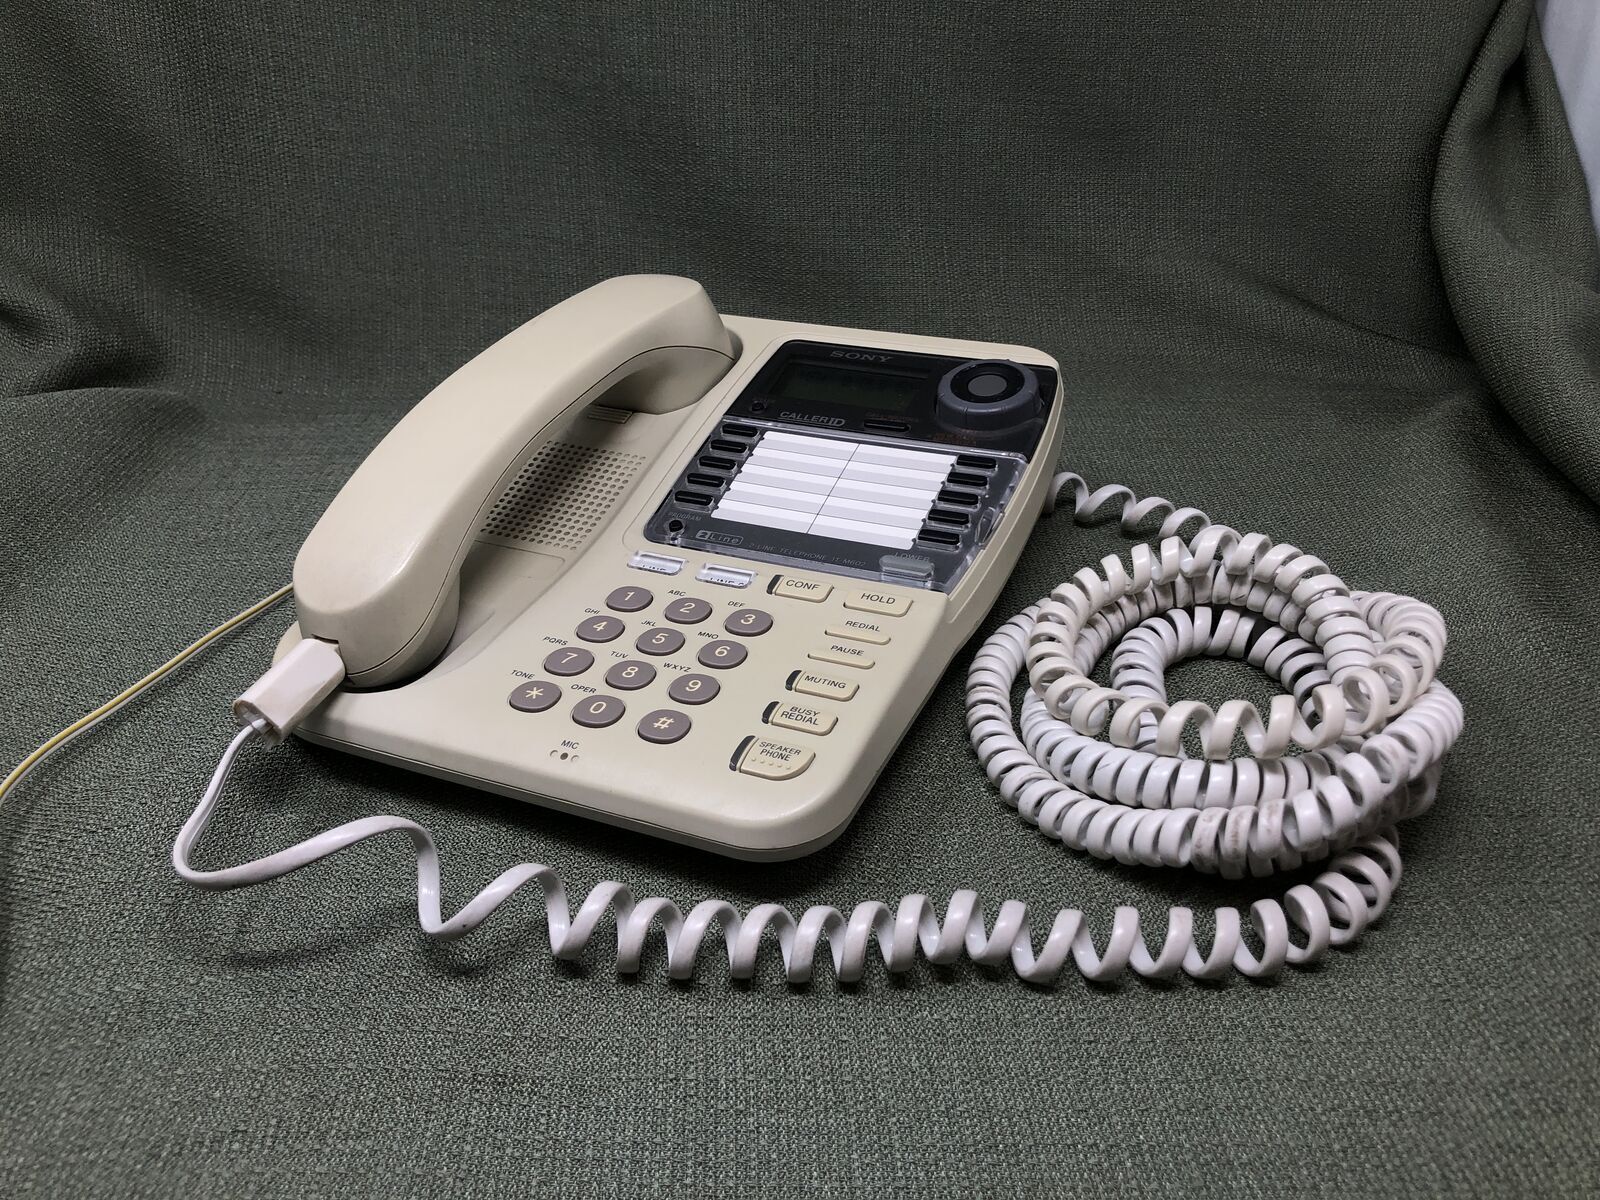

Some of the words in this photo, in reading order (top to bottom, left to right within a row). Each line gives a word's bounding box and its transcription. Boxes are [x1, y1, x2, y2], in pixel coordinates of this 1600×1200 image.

[830, 350, 892, 363] SONY
[786, 578, 820, 591] CONF
[624, 591, 634, 601] 1
[667, 589, 686, 597] ABC
[861, 592, 896, 605] HOLD
[679, 603, 696, 613] 2
[727, 600, 746, 608] DEF
[584, 607, 600, 615] GHI
[641, 619, 657, 627] JKL
[740, 614, 757, 625] 3
[593, 621, 608, 632] 4
[845, 620, 881, 632] REDIAL
[543, 636, 568, 646] PQRS
[652, 633, 669, 644] 5
[697, 631, 719, 640] MNO
[610, 650, 629, 659] TUV
[715, 646, 731, 657] 6
[830, 644, 865, 656] PAUSE
[562, 653, 579, 664] 7
[622, 666, 639, 678] 8
[663, 662, 692, 673] WXYZ
[511, 669, 535, 680] TONE
[685, 679, 701, 692] 9
[804, 675, 847, 689] MUTING
[570, 683, 597, 694] OPER
[590, 701, 606, 714] 0
[789, 706, 820, 717] BUSY
[780, 710, 820, 726] REDIAL
[561, 739, 580, 750] MIC
[759, 741, 802, 756] SPEAKER
[760, 748, 791, 762] PHONE
